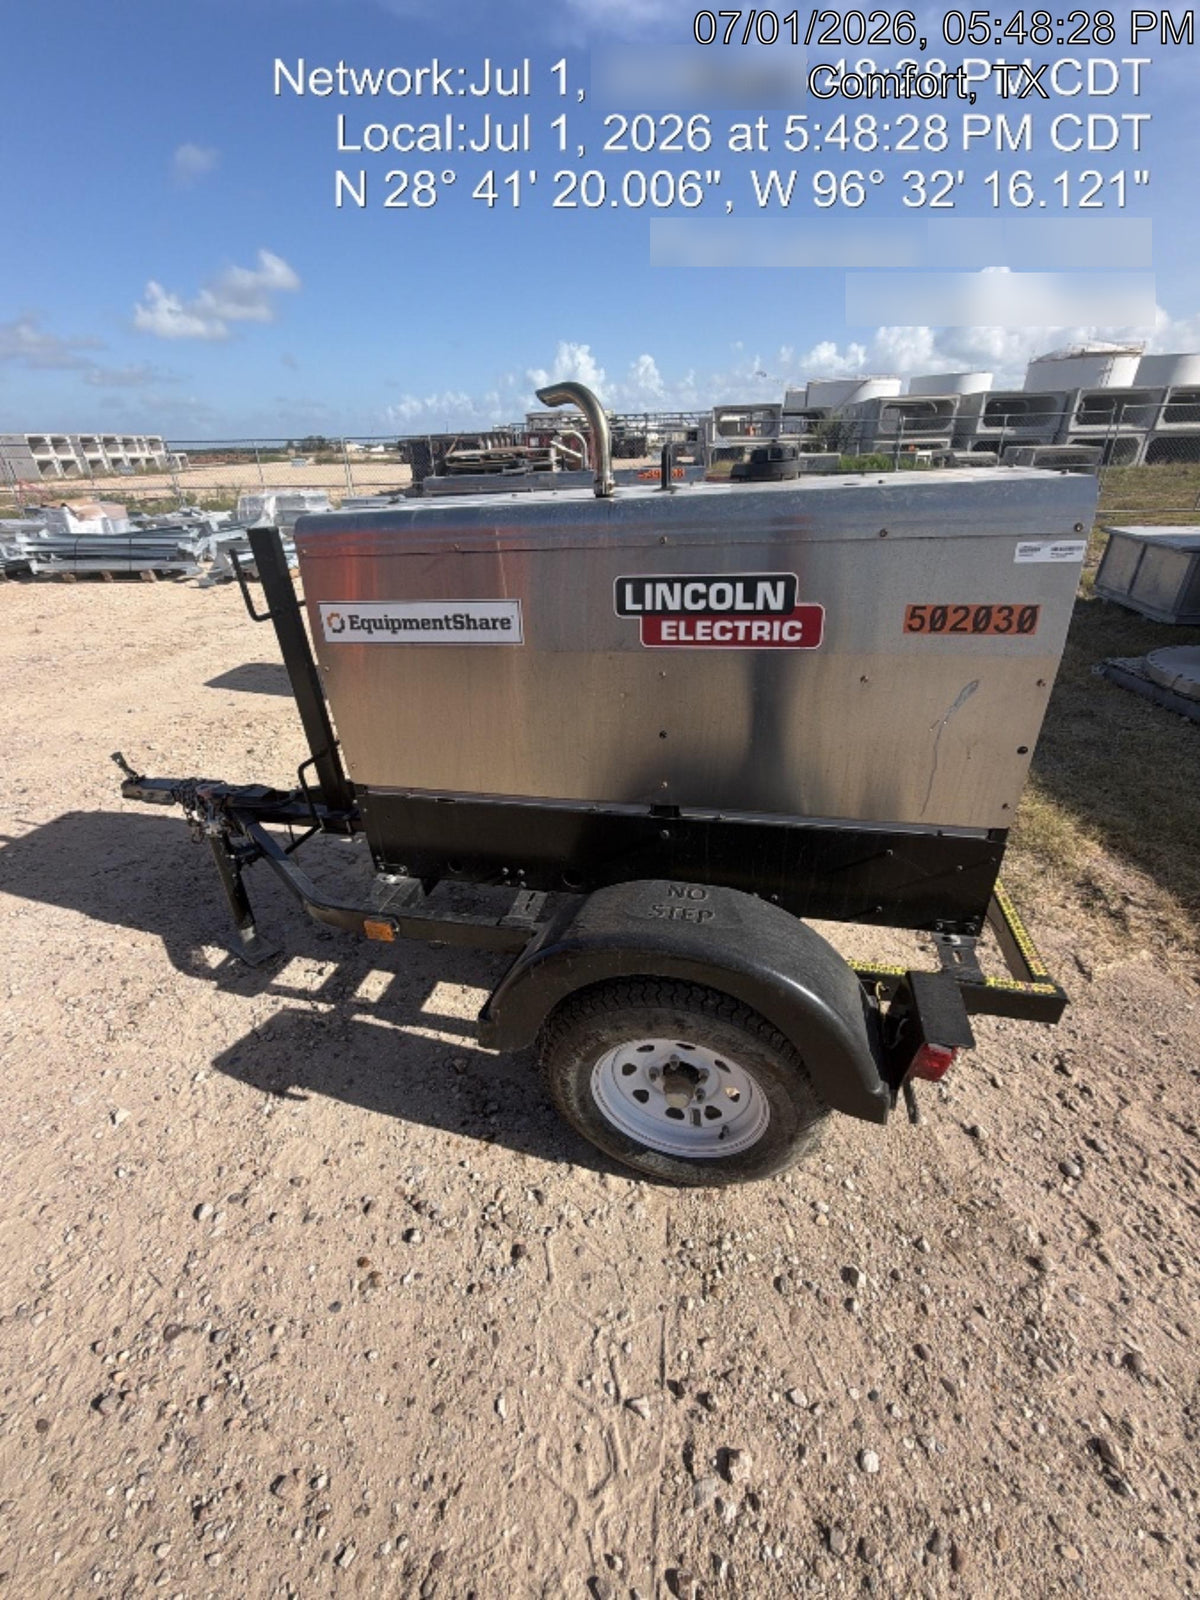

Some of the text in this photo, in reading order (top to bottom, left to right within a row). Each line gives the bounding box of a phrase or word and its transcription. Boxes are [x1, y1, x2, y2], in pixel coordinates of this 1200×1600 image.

[624, 581, 786, 611] LINCOLN
[347, 613, 512, 635] EquipmentShare
[907, 604, 1040, 633] 502030
[660, 619, 803, 641] ELECTRIC
[667, 885, 708, 901] NO
[648, 904, 715, 923] STEP
